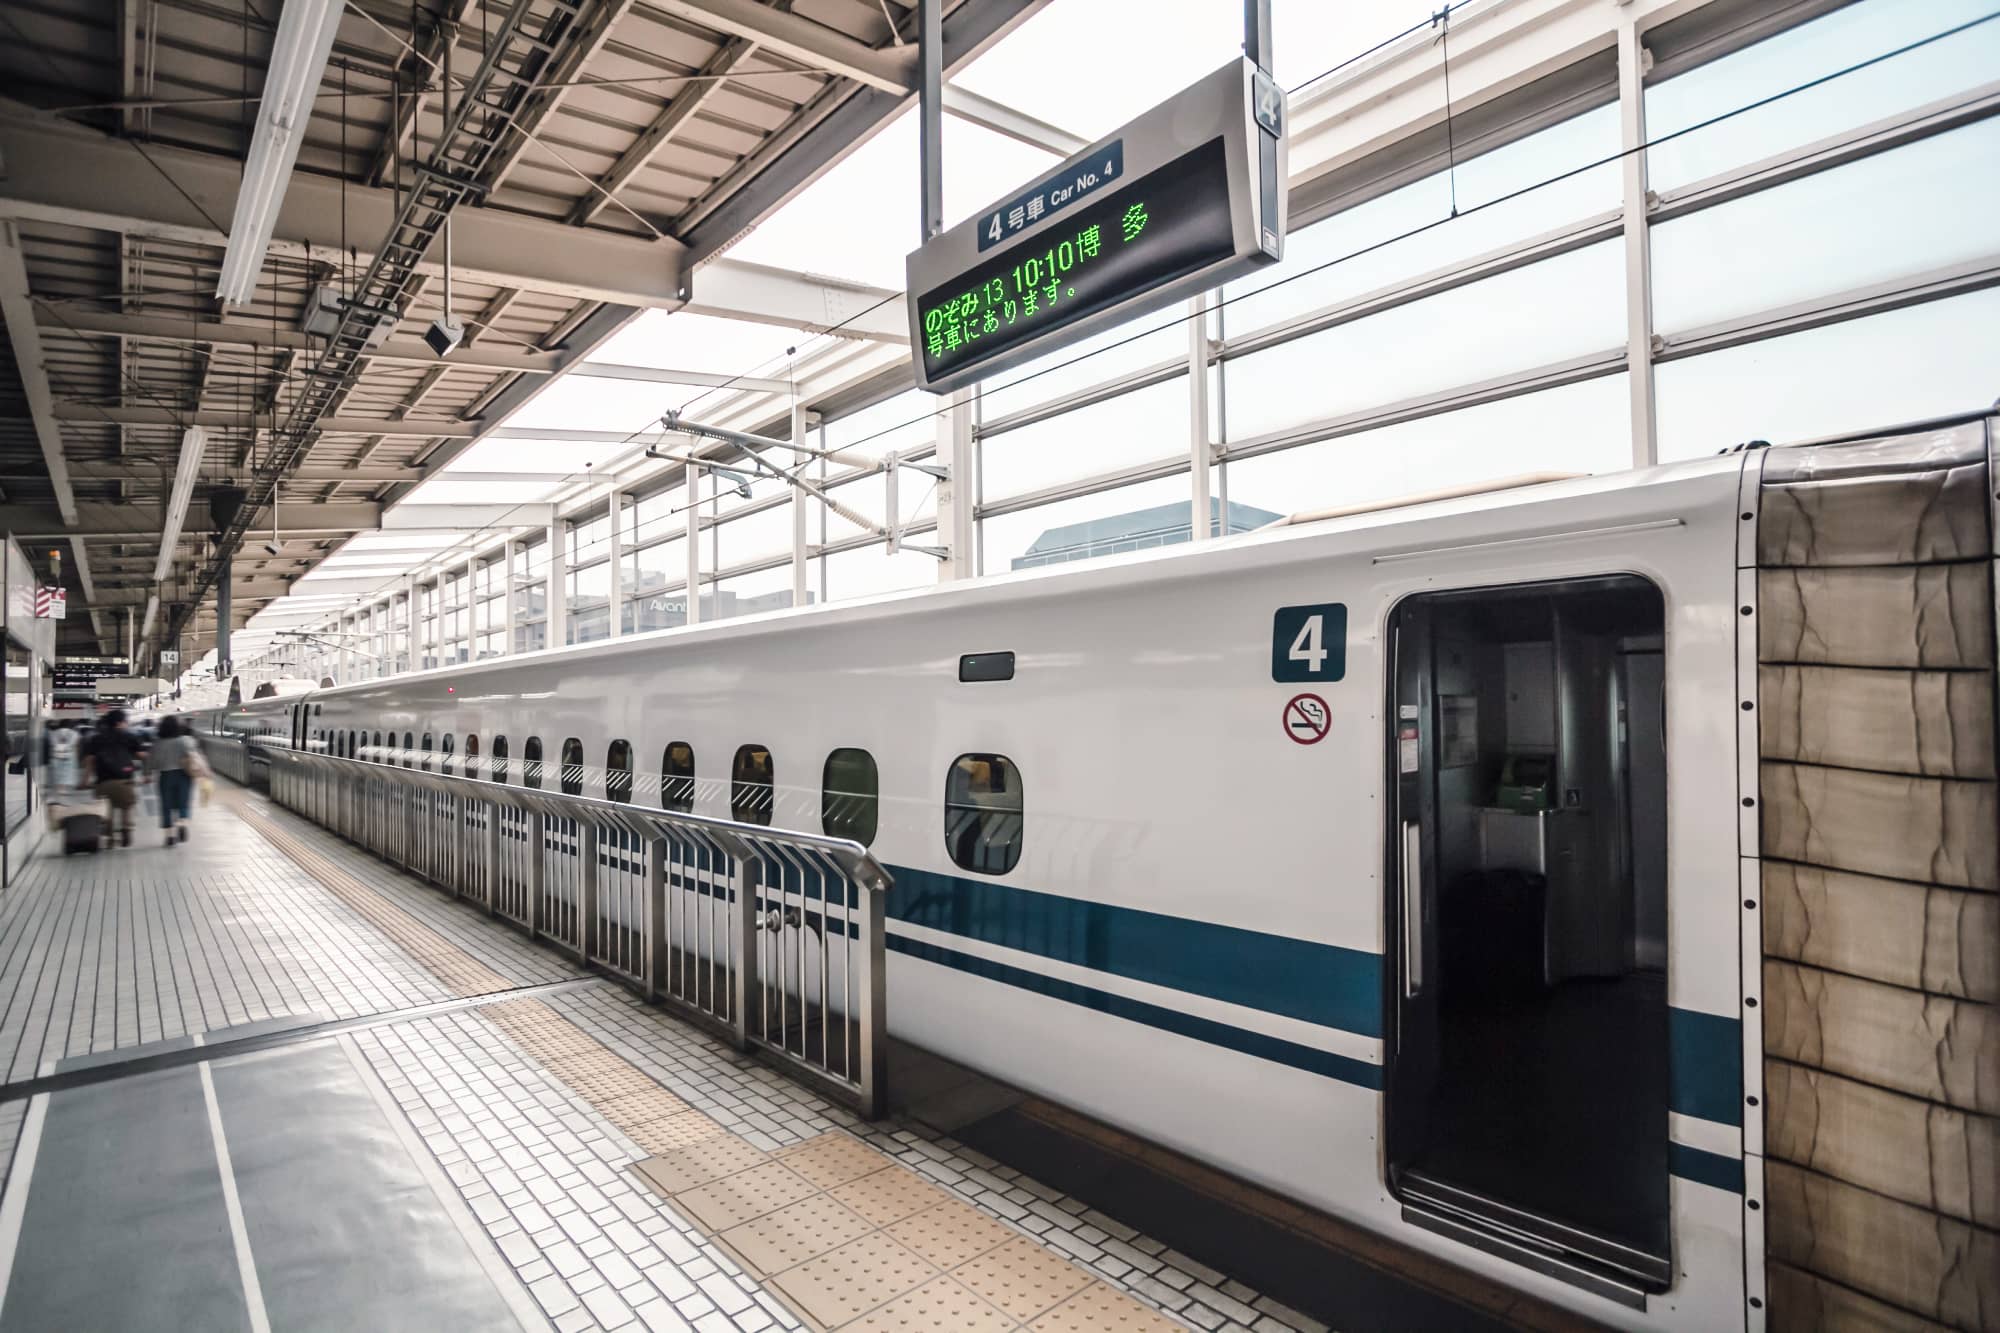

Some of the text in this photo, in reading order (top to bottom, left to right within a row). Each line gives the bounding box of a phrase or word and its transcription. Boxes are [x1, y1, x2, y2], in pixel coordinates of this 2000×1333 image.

[1261, 90, 1277, 126] 4
[1051, 184, 1074, 206] Car
[1077, 174, 1099, 192] No.
[1104, 160, 1113, 176] 4
[926, 292, 979, 333] のぞみ
[984, 278, 1004, 305] 13
[1012, 241, 1074, 292] 10:10
[927, 278, 1075, 358] 号車にあります。
[164, 653, 175, 662] 14
[1289, 614, 1328, 672] 4
